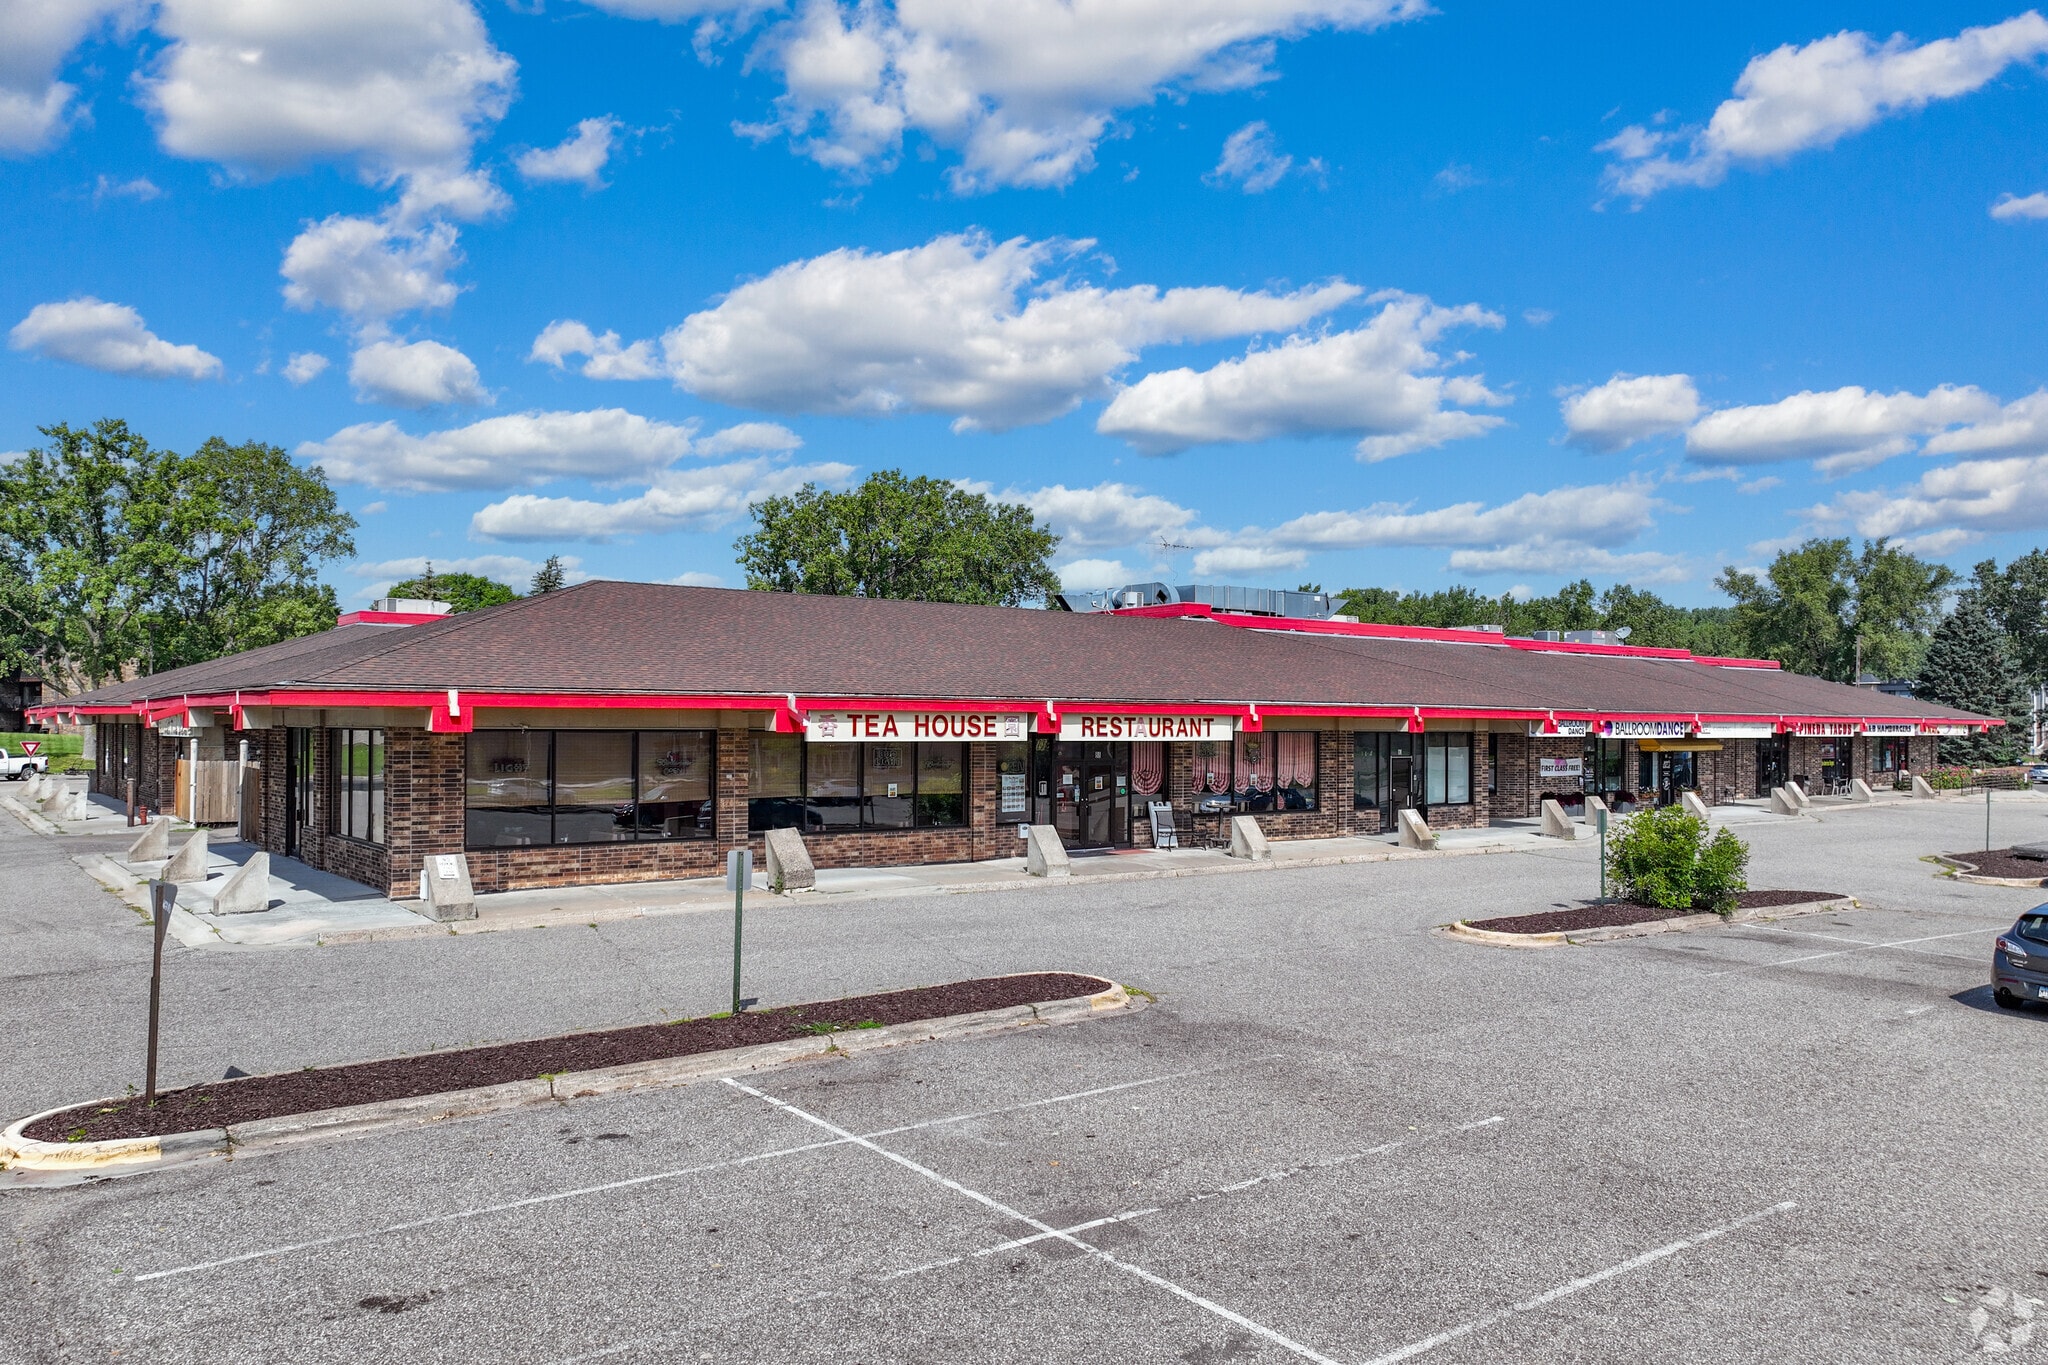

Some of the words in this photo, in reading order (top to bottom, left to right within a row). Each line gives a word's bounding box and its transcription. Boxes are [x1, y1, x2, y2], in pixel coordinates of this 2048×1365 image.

[847, 714, 899, 738] TEA
[914, 714, 998, 738] HOUSE
[1081, 716, 1215, 738] RESTAURANT
[1567, 727, 1585, 735] DANCE
[1799, 722, 1826, 736] PINEDA
[1829, 722, 1852, 736] TACOS
[1876, 724, 1912, 733] HAMBURGERS
[494, 762, 530, 773] LIGHT
[1541, 764, 1554, 772] FIRST
[1554, 764, 1568, 772] CLASS
[1568, 763, 1581, 772] FREE!
